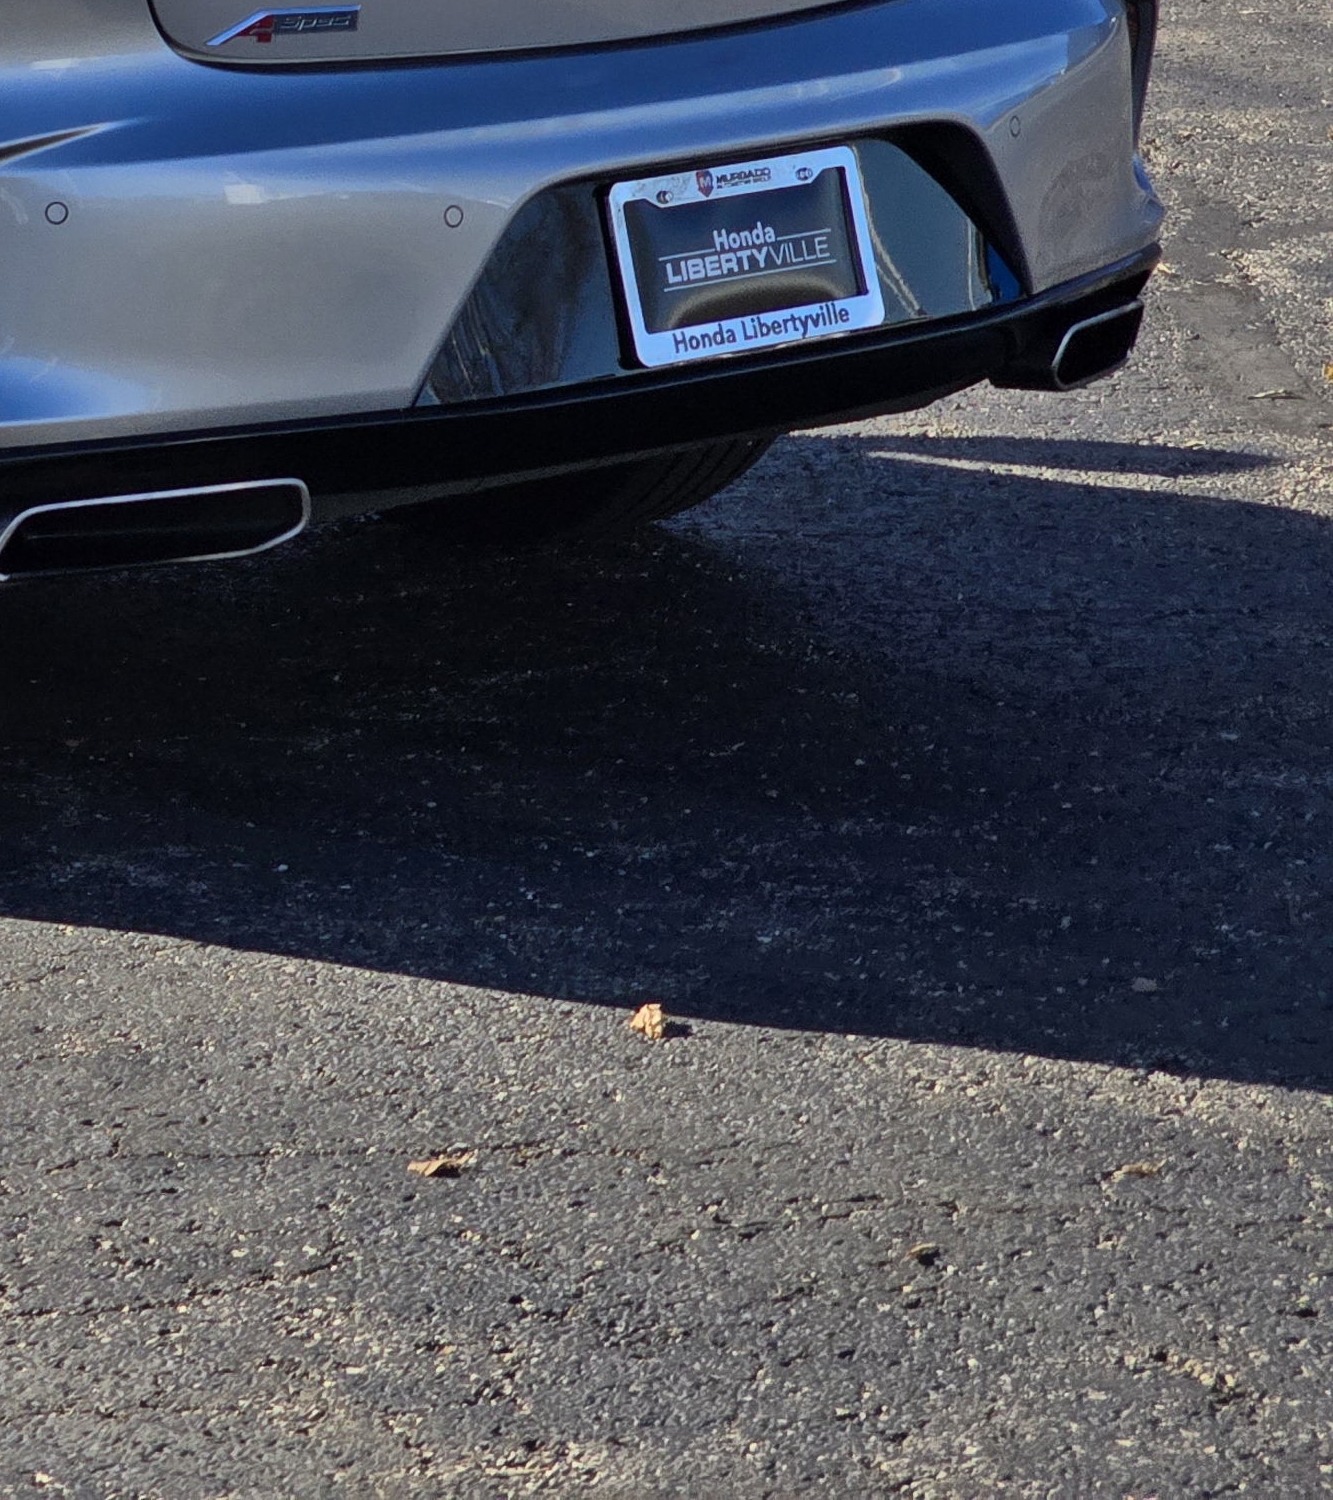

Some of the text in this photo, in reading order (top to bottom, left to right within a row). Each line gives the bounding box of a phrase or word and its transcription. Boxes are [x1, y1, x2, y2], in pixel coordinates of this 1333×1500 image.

[666, 236, 831, 284] LIBERTYVILLE
[713, 221, 776, 251] Honda
[673, 302, 850, 354] Honda Libertyville
